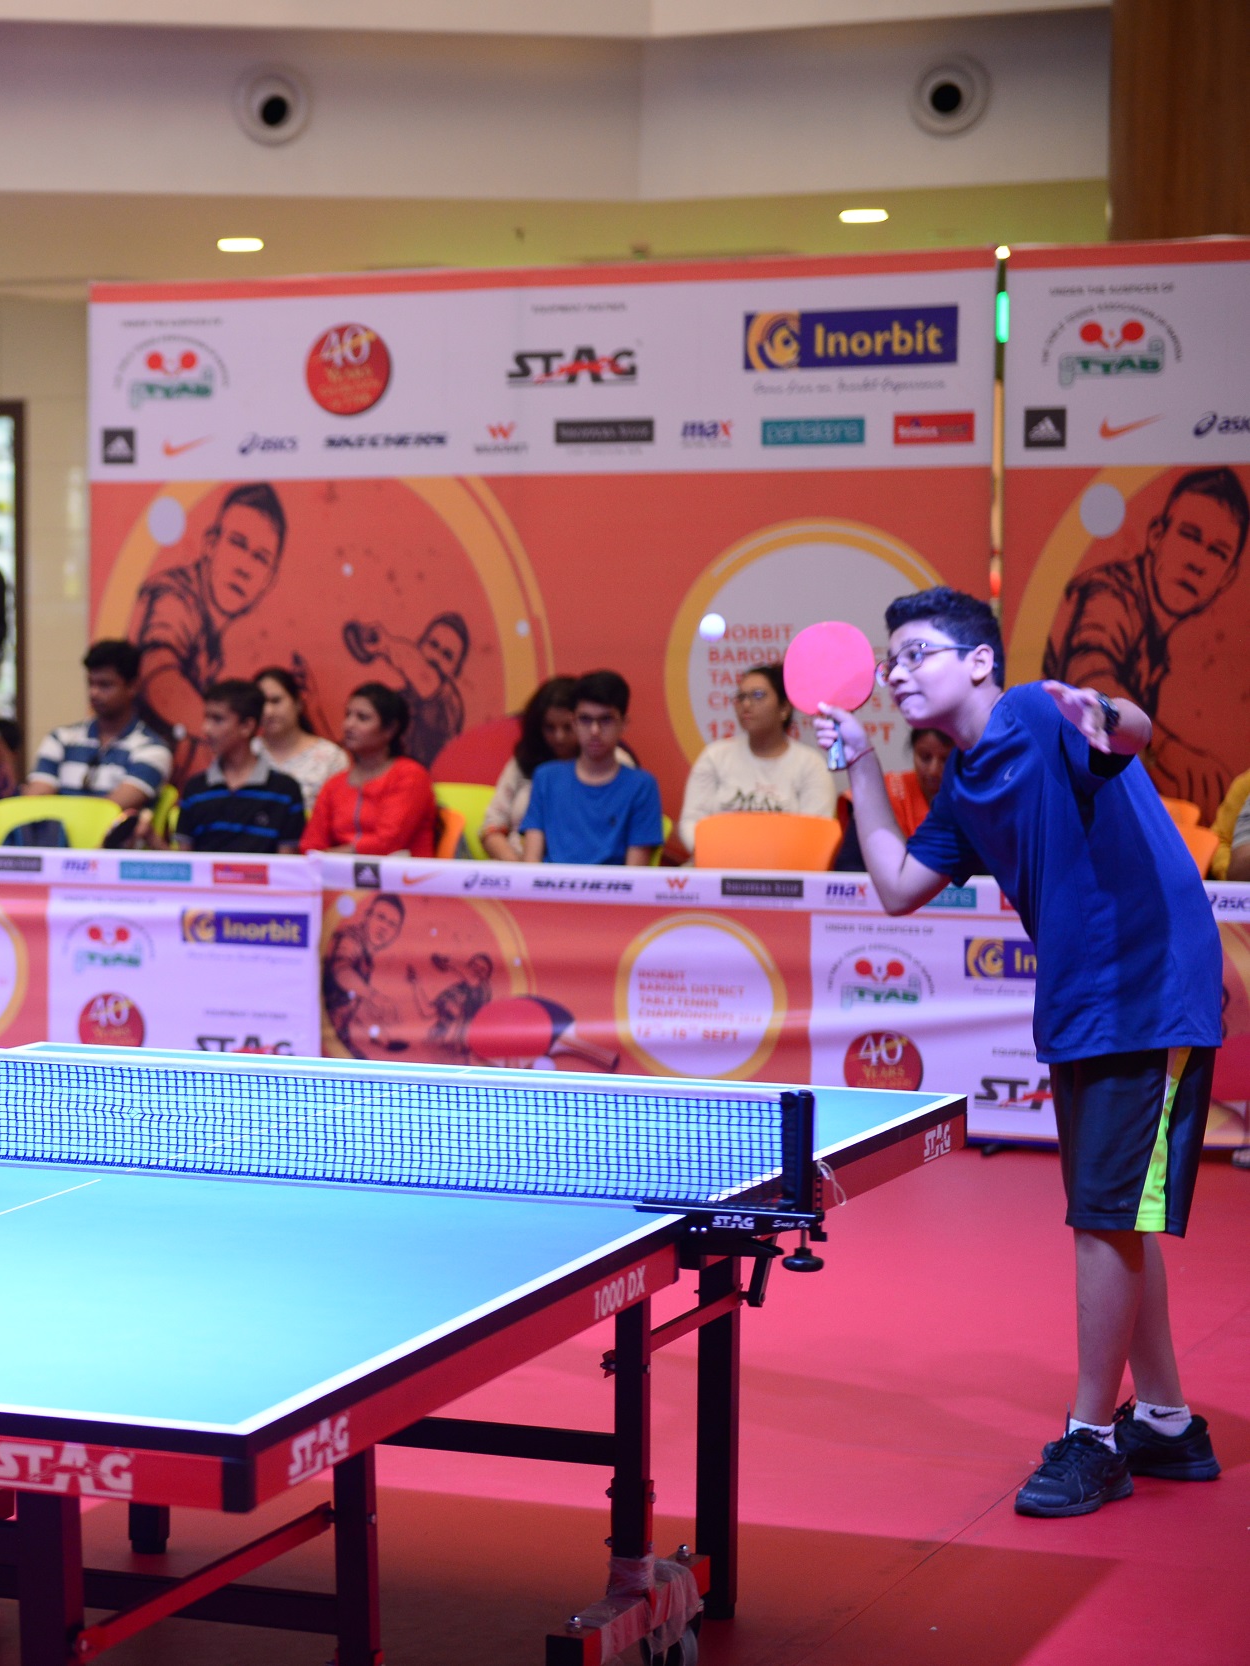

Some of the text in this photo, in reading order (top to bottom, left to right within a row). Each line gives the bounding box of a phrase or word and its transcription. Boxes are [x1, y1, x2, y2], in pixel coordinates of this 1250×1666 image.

[320, 327, 370, 367] 40
[814, 320, 943, 358] Inorbit
[507, 346, 637, 386] STAG
[681, 420, 732, 440] max
[721, 624, 792, 641] NORBIT
[862, 721, 896, 743] PT
[532, 877, 634, 892] SKECHERS
[826, 882, 867, 898] max
[1218, 896, 1250, 911] asic
[222, 917, 302, 943] Inorbit
[89, 995, 130, 1027] 40
[702, 1028, 739, 1042] SEPT
[859, 1033, 904, 1067] 40
[974, 1077, 1053, 1111] STA
[924, 1123, 951, 1163] STAG
[712, 1215, 755, 1230] STAG
[594, 1264, 646, 1320] 1000 DX
[289, 1411, 350, 1486] STAG
